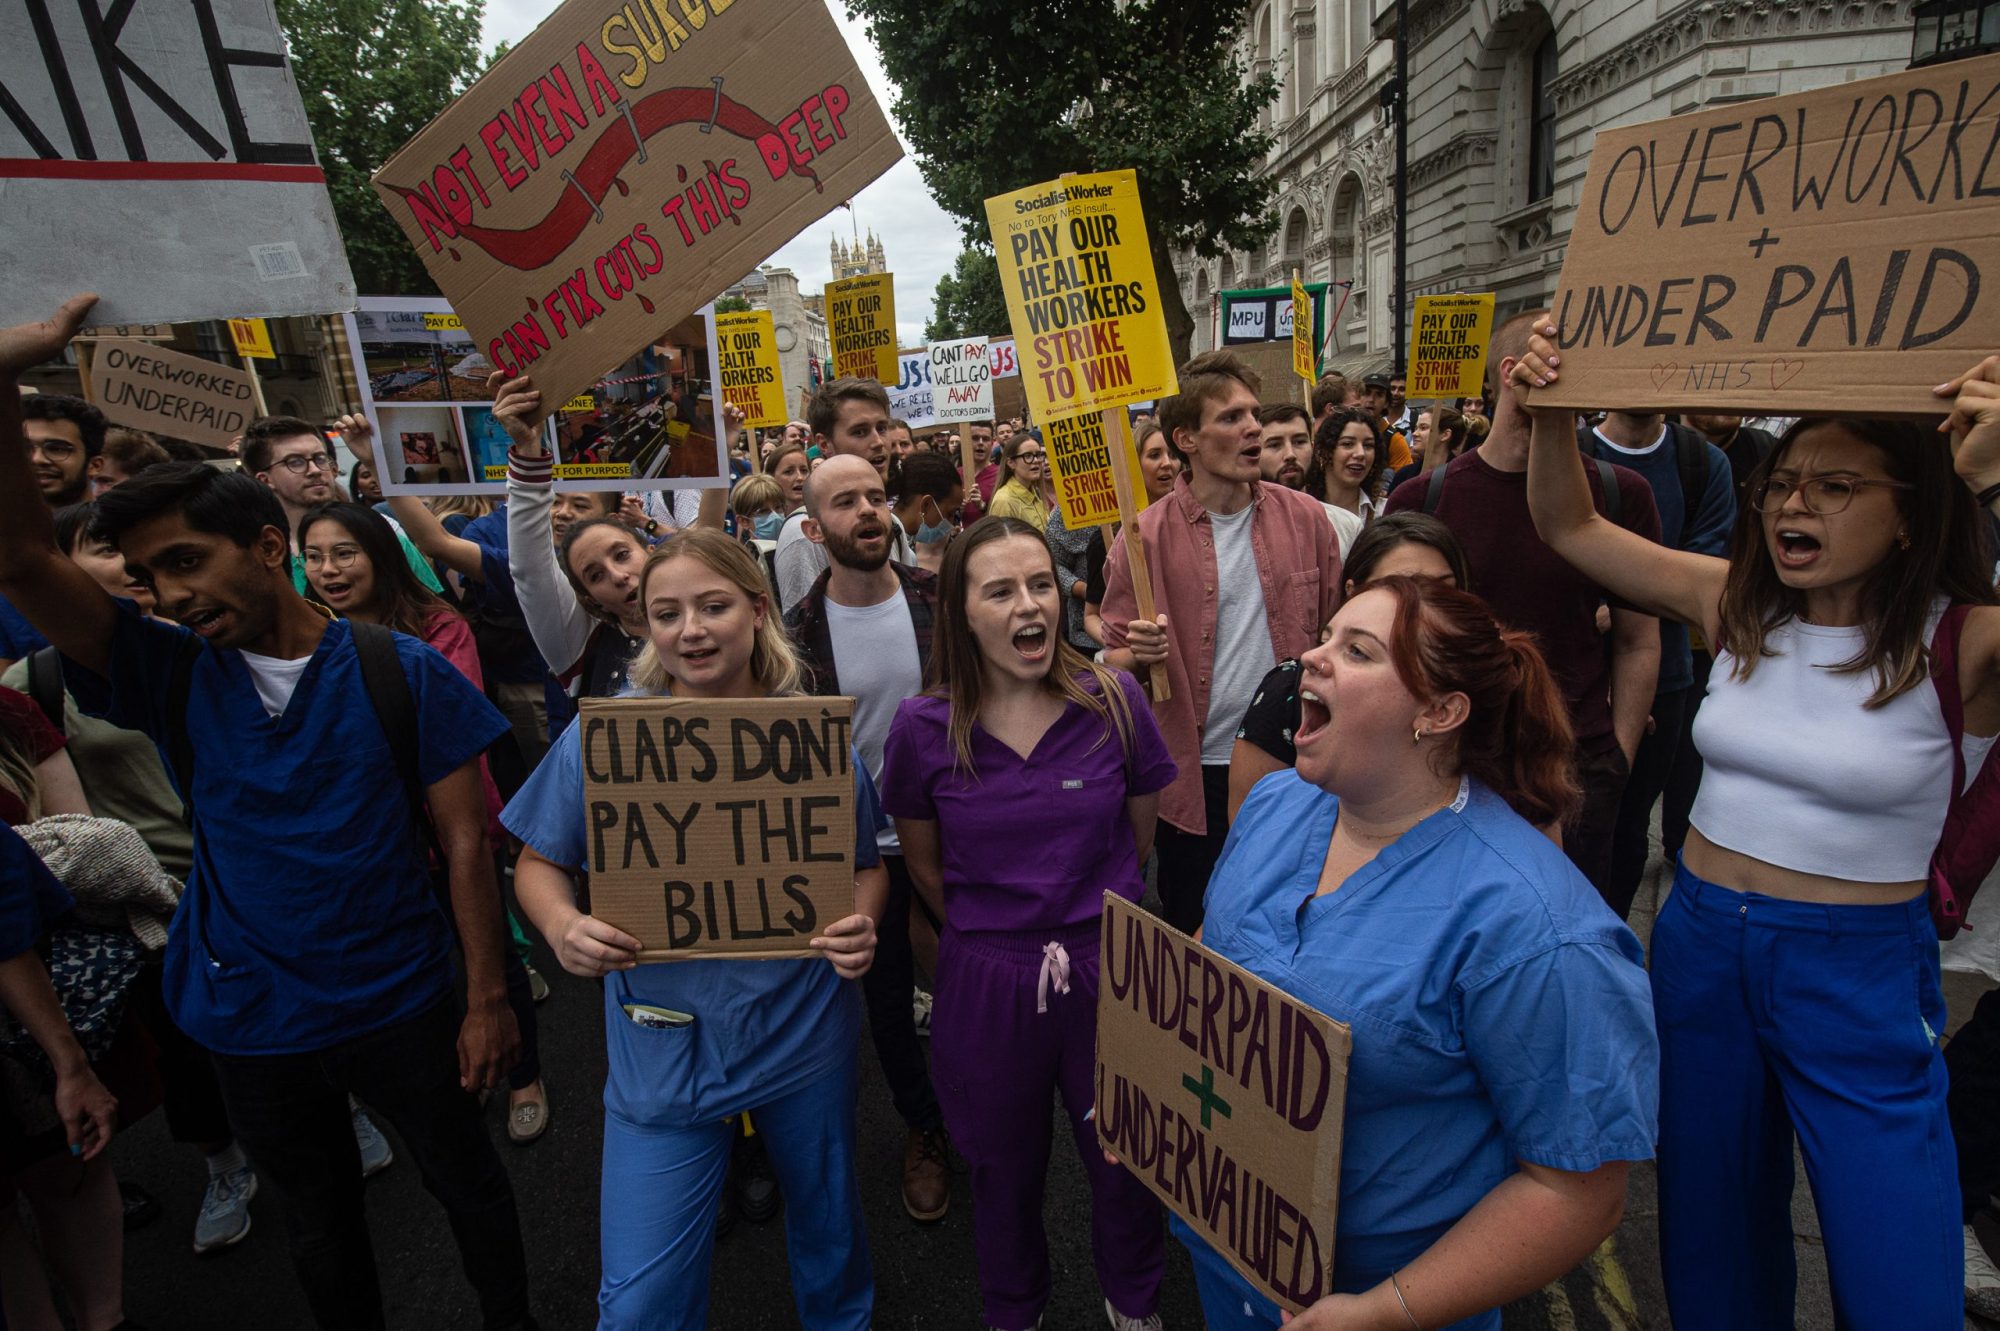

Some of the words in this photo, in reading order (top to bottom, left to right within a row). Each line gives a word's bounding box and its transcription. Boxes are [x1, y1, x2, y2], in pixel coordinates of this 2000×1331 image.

[405, 143, 492, 254] NOT
[478, 62, 590, 192] EVEN
[575, 40, 622, 118] A
[543, 267, 606, 339] FIX
[594, 223, 663, 300] CUTS
[661, 159, 751, 247] THIS
[754, 84, 850, 181] DEEP
[1014, 188, 1071, 214] Socialist
[1070, 183, 1113, 200] Worker
[1008, 222, 1022, 232] No
[1024, 219, 1034, 228] to
[1037, 212, 1057, 225] Tory
[1060, 205, 1081, 219] NHS
[1011, 223, 1059, 267] PAY
[1070, 214, 1121, 250] OUR
[1018, 250, 1112, 301] HEALTH
[832, 299, 852, 319] PAY
[858, 295, 881, 314] OUR
[1024, 281, 1146, 335] WORKERS
[1231, 311, 1264, 326] MPU
[425, 318, 445, 328] PAY
[834, 314, 875, 337] HEALTH
[1421, 314, 1446, 329] PAY
[1450, 313, 1477, 328] OUR
[733, 332, 761, 350] OUR
[836, 329, 890, 354] WORKERS
[1033, 320, 1125, 370] STRIKE
[1419, 330, 1467, 345] HEALTH
[838, 348, 877, 374] STRIKE
[932, 344, 963, 366] CANT
[964, 343, 987, 361] PAY?
[1418, 345, 1480, 360] WORKERS
[107, 349, 252, 400] OVERWORKED
[856, 364, 878, 379] WIN
[969, 364, 989, 382] GO
[1040, 367, 1076, 403] TO
[1081, 354, 1133, 393] WIN
[1416, 360, 1461, 375] STRIKE
[1683, 361, 1756, 391] NHS
[948, 385, 981, 404] AWAY
[1415, 376, 1430, 391] TO
[1435, 375, 1460, 390] WIN
[103, 378, 244, 433] UNDERPAID
[739, 401, 764, 419] WIN
[908, 406, 922, 419] WE
[1049, 417, 1074, 436] PAY
[1052, 426, 1103, 457] HEALTH
[485, 468, 506, 478] NHS
[563, 467, 583, 476] FOR
[585, 466, 630, 476] PURPOSE
[1063, 469, 1112, 498] STRIKE
[1067, 497, 1087, 518] TO
[1089, 490, 1119, 513] WIN
[584, 716, 718, 784] CLAPS
[730, 707, 851, 784] DON'T
[590, 801, 701, 873] PAY
[715, 796, 845, 866] THE
[664, 874, 817, 950] BILLS
[1106, 905, 1331, 1132] UNDERPAID
[1099, 1062, 1324, 1308] UNDERVALUED
